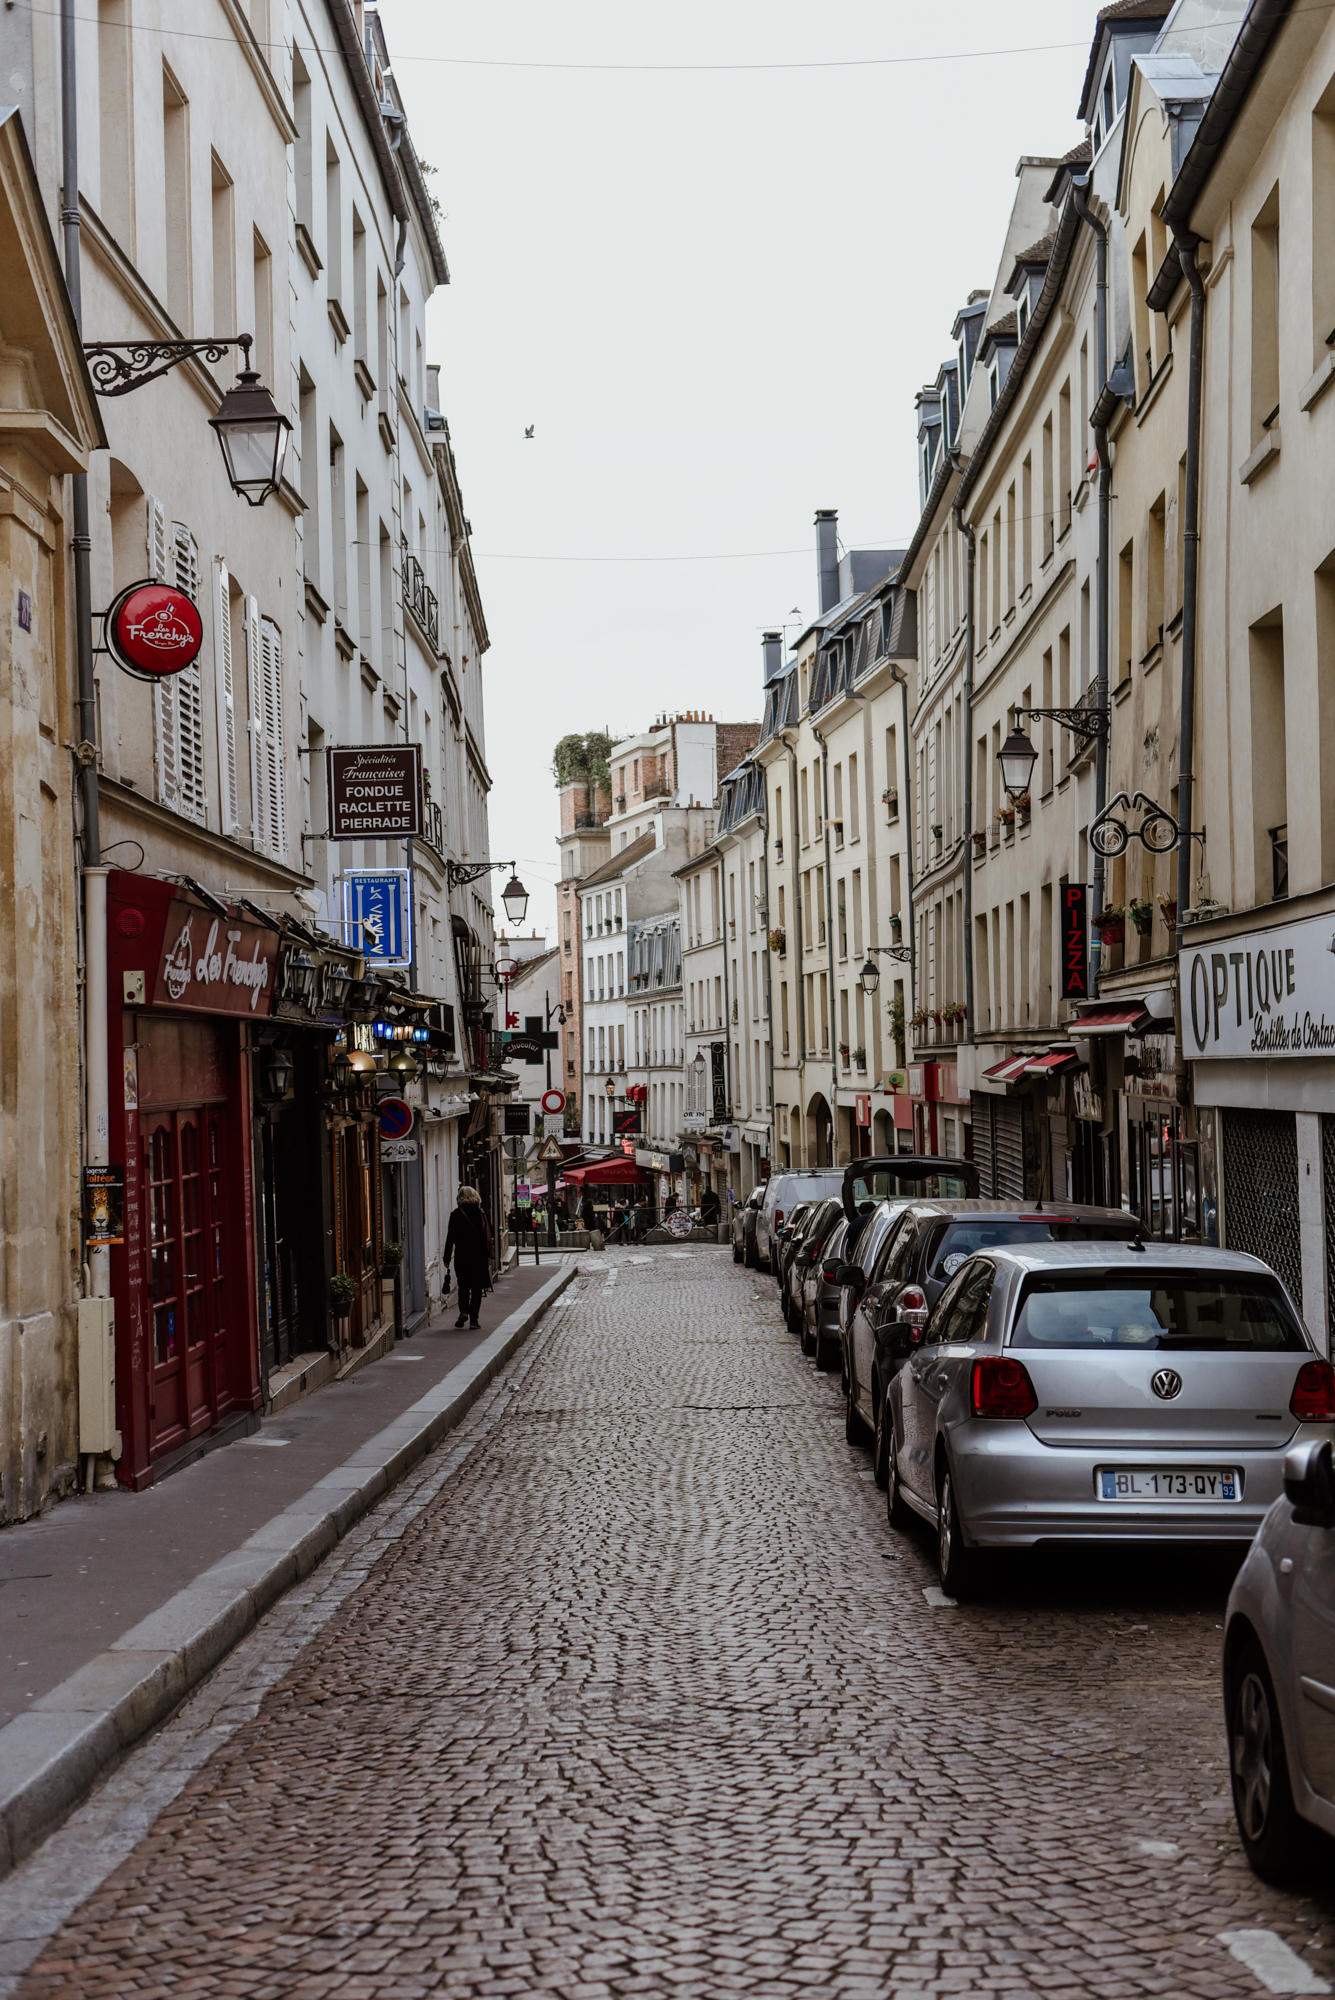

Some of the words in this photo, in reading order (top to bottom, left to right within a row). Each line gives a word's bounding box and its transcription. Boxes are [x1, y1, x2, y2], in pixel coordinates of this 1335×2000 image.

[354, 753, 397, 768] Spécialités
[342, 766, 406, 782] Françaises
[346, 785, 404, 798] FONDUE
[339, 801, 411, 814] RACLETTE
[341, 816, 410, 829] PIERRADE
[369, 886, 383, 900] LA
[1066, 889, 1085, 991] PIZZA
[195, 919, 222, 985] Les
[1190, 948, 1296, 1053] OPTIQUE
[1251, 1010, 1290, 1052] Lentilles
[1291, 1011, 1302, 1050] de
[1118, 1474, 1217, 1495] BL-173-QY
[1223, 1486, 1235, 1497] 92
